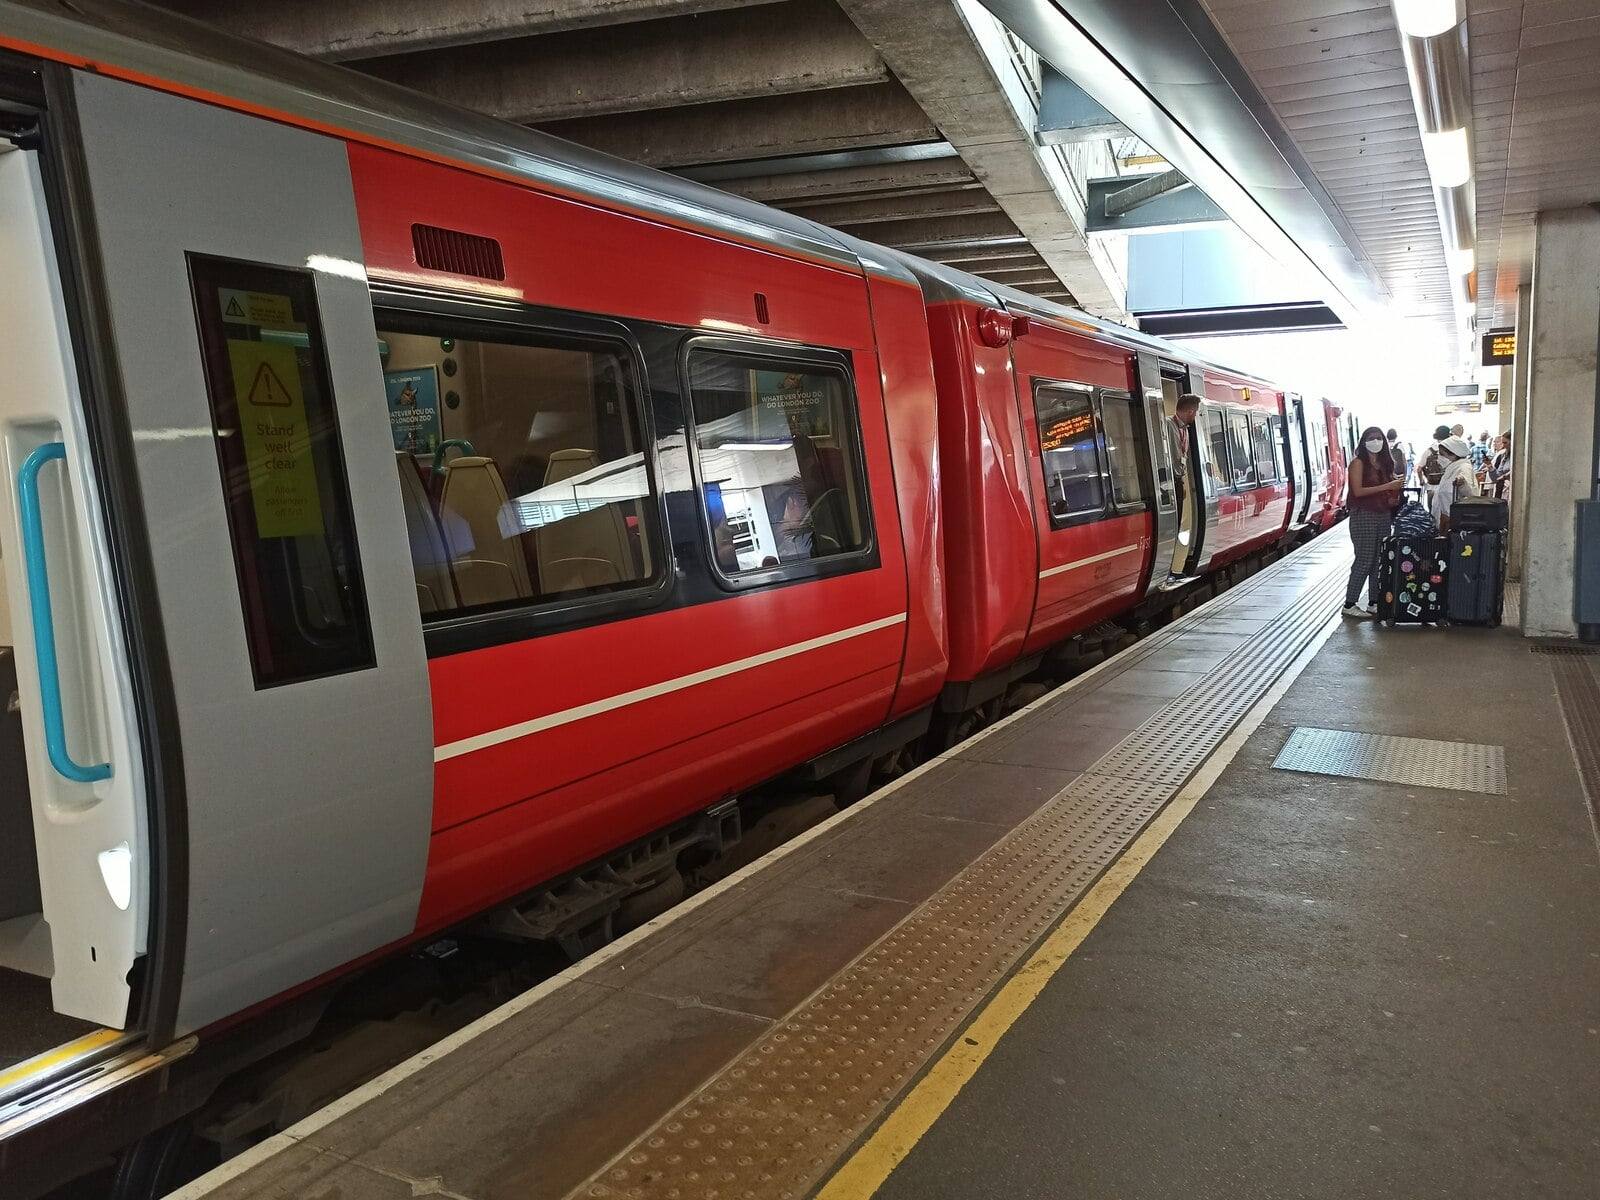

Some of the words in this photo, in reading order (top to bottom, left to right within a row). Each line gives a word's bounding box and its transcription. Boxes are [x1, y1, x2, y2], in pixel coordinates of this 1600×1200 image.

[761, 393, 797, 402] WHATEVER
[1490, 393, 1497, 401] 7
[777, 400, 805, 408] LONDON
[805, 398, 820, 406] ZOO
[391, 408, 412, 418] ATEVER
[412, 408, 425, 416] YOU
[397, 415, 419, 424] LONDON
[419, 414, 432, 422] ZOO
[256, 422, 294, 436] Stand
[264, 440, 292, 454] well
[265, 458, 297, 470] clear
